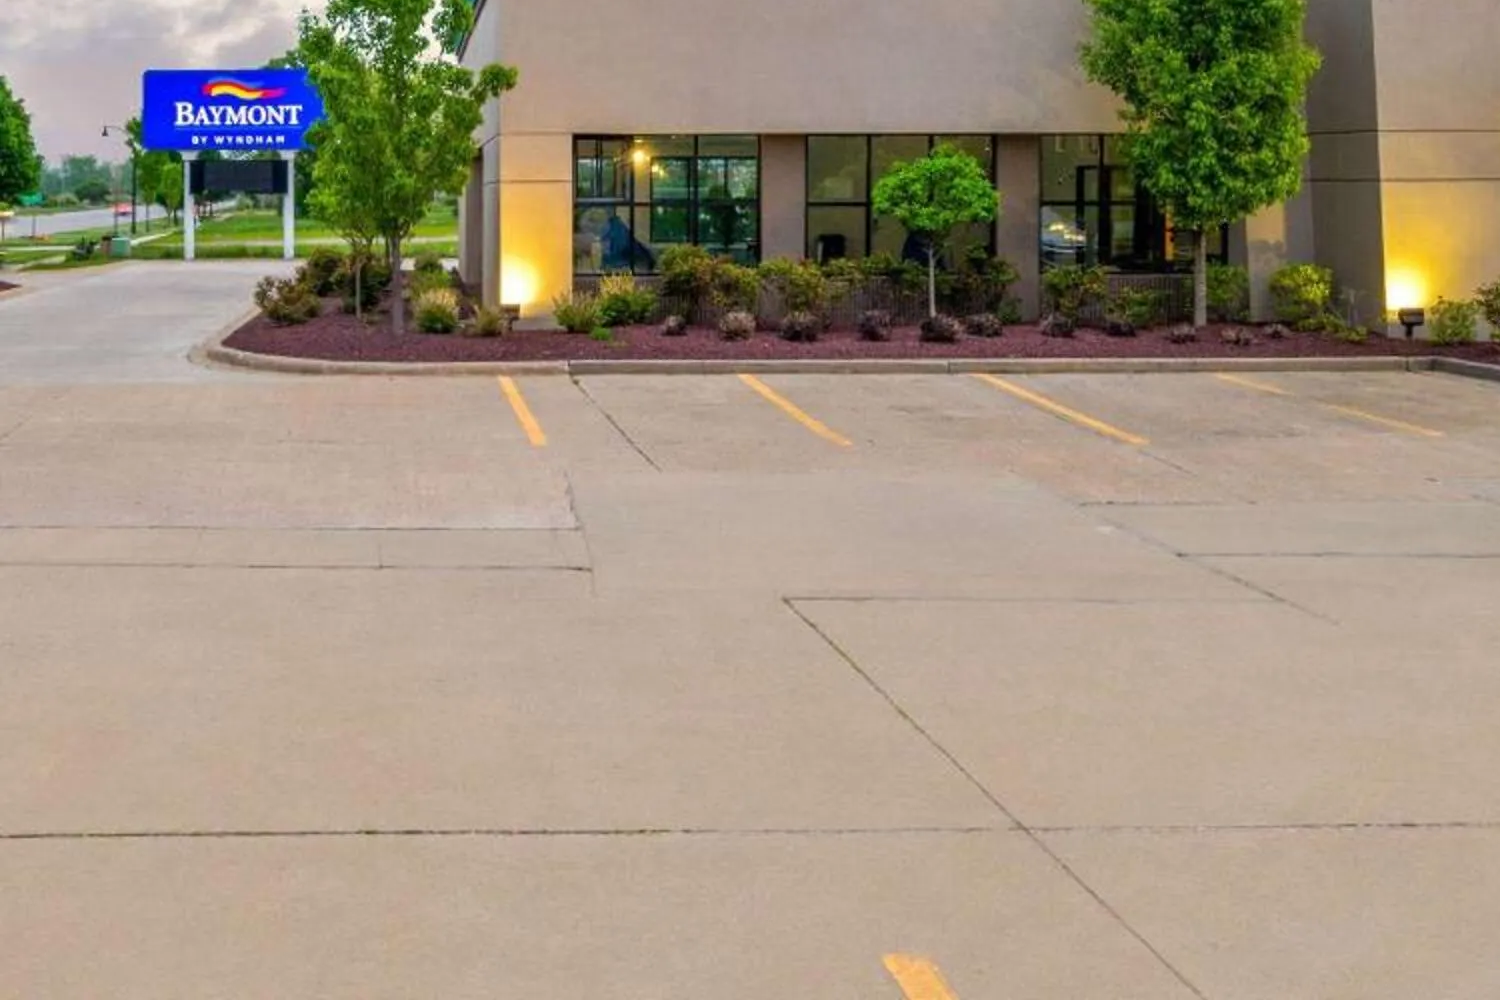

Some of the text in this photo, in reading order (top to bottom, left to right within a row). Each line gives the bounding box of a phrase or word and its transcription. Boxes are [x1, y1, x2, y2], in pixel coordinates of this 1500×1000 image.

[174, 102, 303, 126] BAYMONT
[191, 135, 286, 145] BY WYNDHAM
